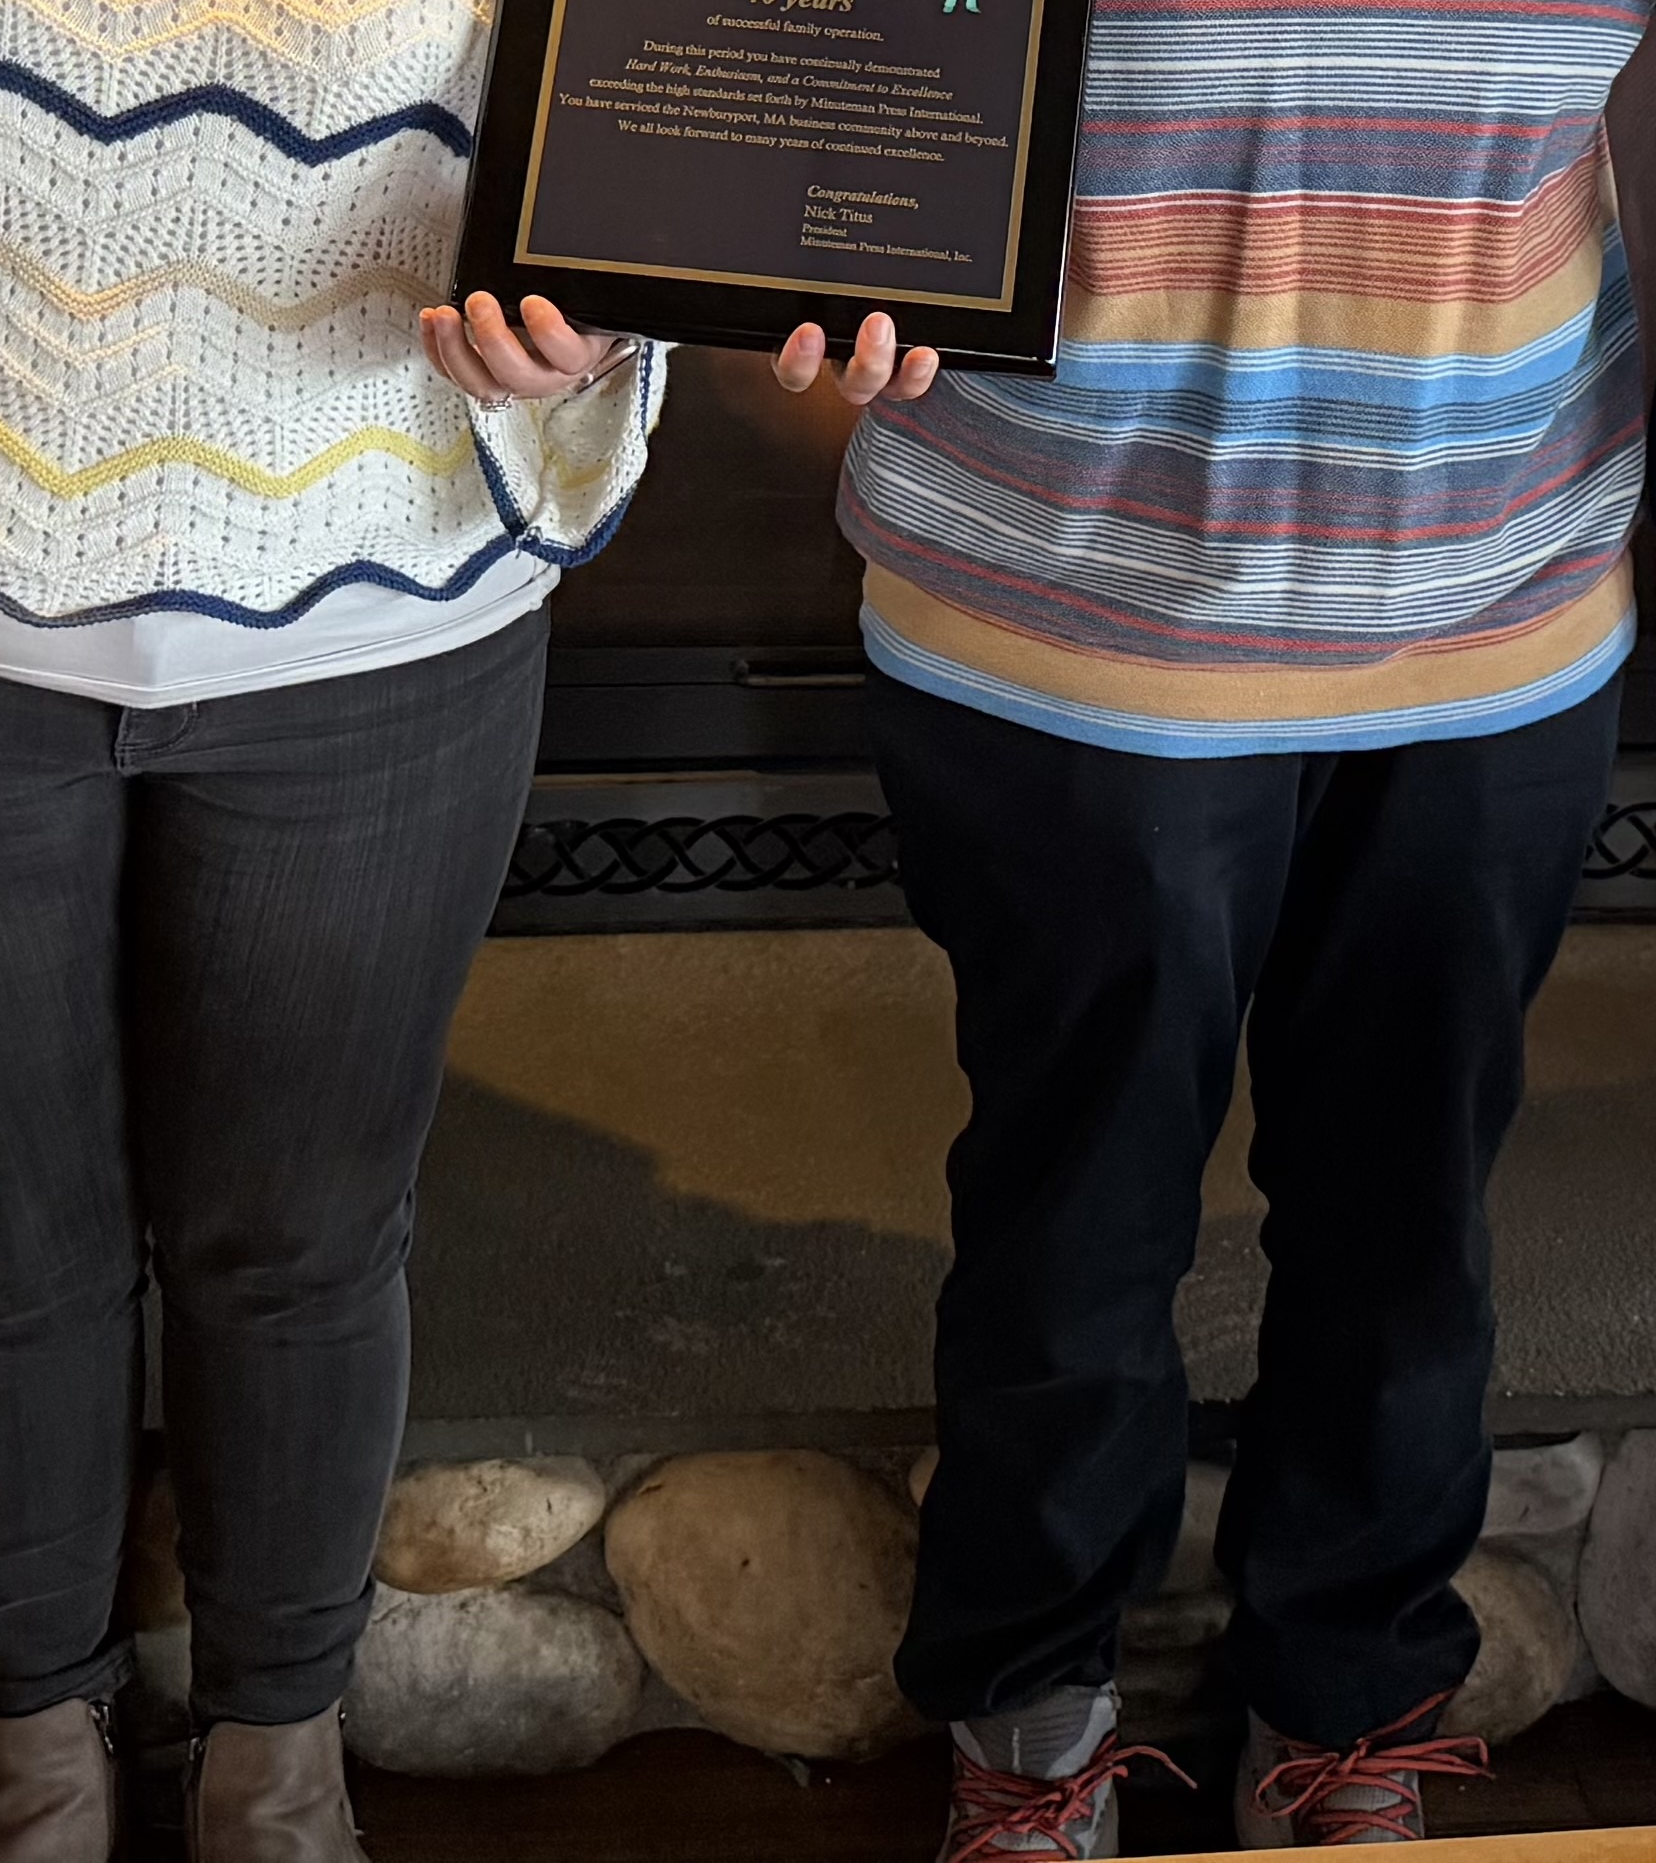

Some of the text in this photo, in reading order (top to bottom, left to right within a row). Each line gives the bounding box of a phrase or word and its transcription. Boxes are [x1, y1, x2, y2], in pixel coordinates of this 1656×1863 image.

[707, 14, 884, 41] of successful family operation.
[644, 40, 683, 56] During
[686, 45, 706, 56] this
[708, 47, 744, 59] period
[747, 52, 768, 63] you
[771, 52, 797, 65] have
[800, 57, 862, 73] continually
[626, 59, 657, 71] Hard
[767, 74, 791, 85] and
[803, 76, 875, 92] Commitment
[877, 85, 889, 93] to
[891, 84, 953, 100] Excellence
[589, 78, 984, 124] exceeding the high standards set forth by Minuteman Press International.
[559, 93, 1009, 147] You have serviced the Newburyport, MA business community above and beyond.
[618, 119, 945, 161] We all look forward to many years of continued excellence.
[807, 185, 919, 210] Congratulations,
[804, 205, 873, 223] Nick Titus
[802, 223, 847, 237] President
[800, 236, 973, 262] Minuteman Press International, Inc.
